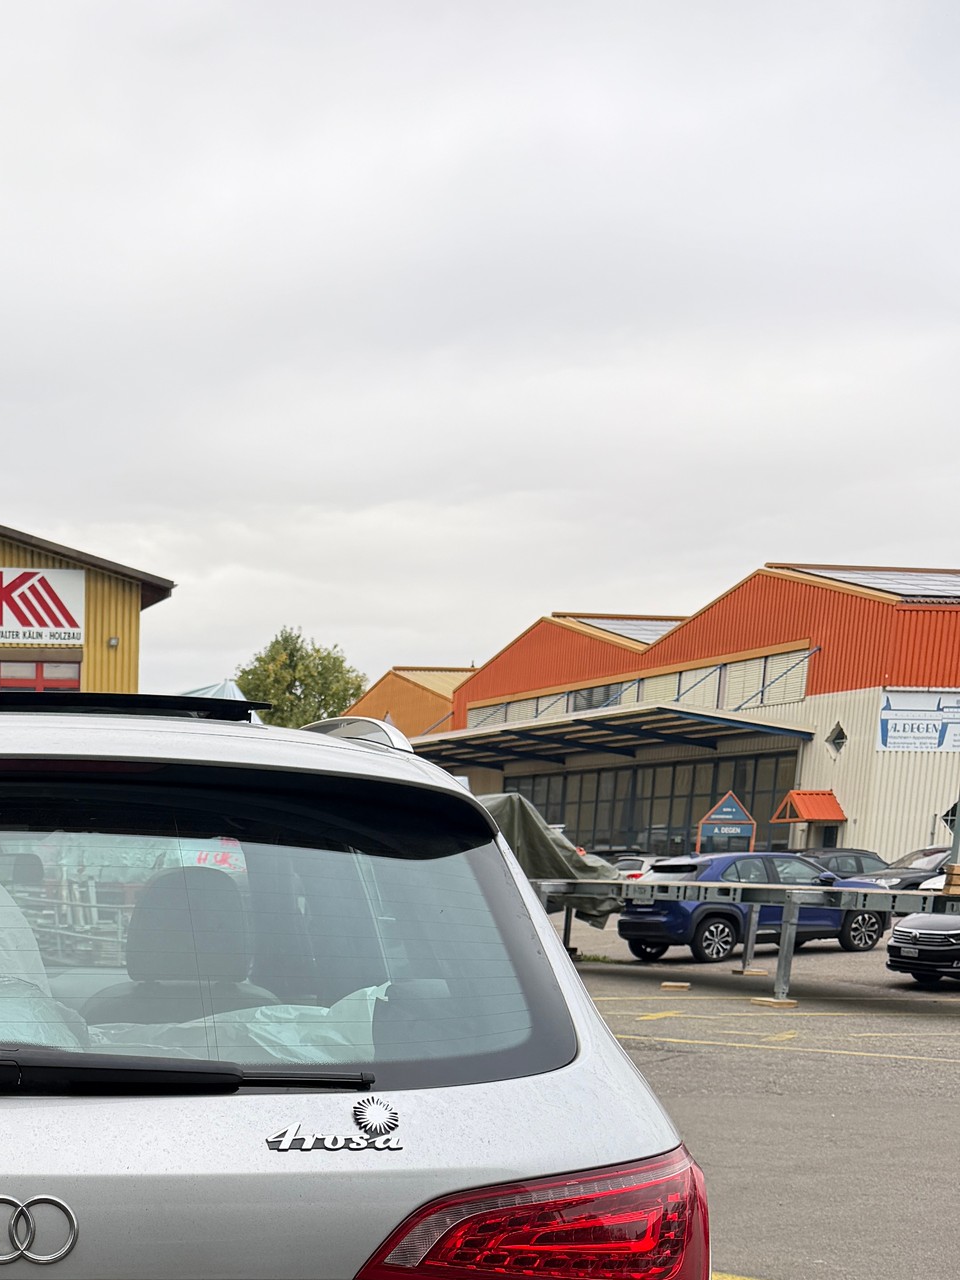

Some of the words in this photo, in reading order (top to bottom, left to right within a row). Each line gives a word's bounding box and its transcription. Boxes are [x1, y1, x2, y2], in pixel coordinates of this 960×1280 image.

[22, 629, 43, 640] KÄLIN
[49, 631, 82, 641] HOLZBAU
[888, 722, 900, 733] A.
[902, 722, 939, 734] DEGEN
